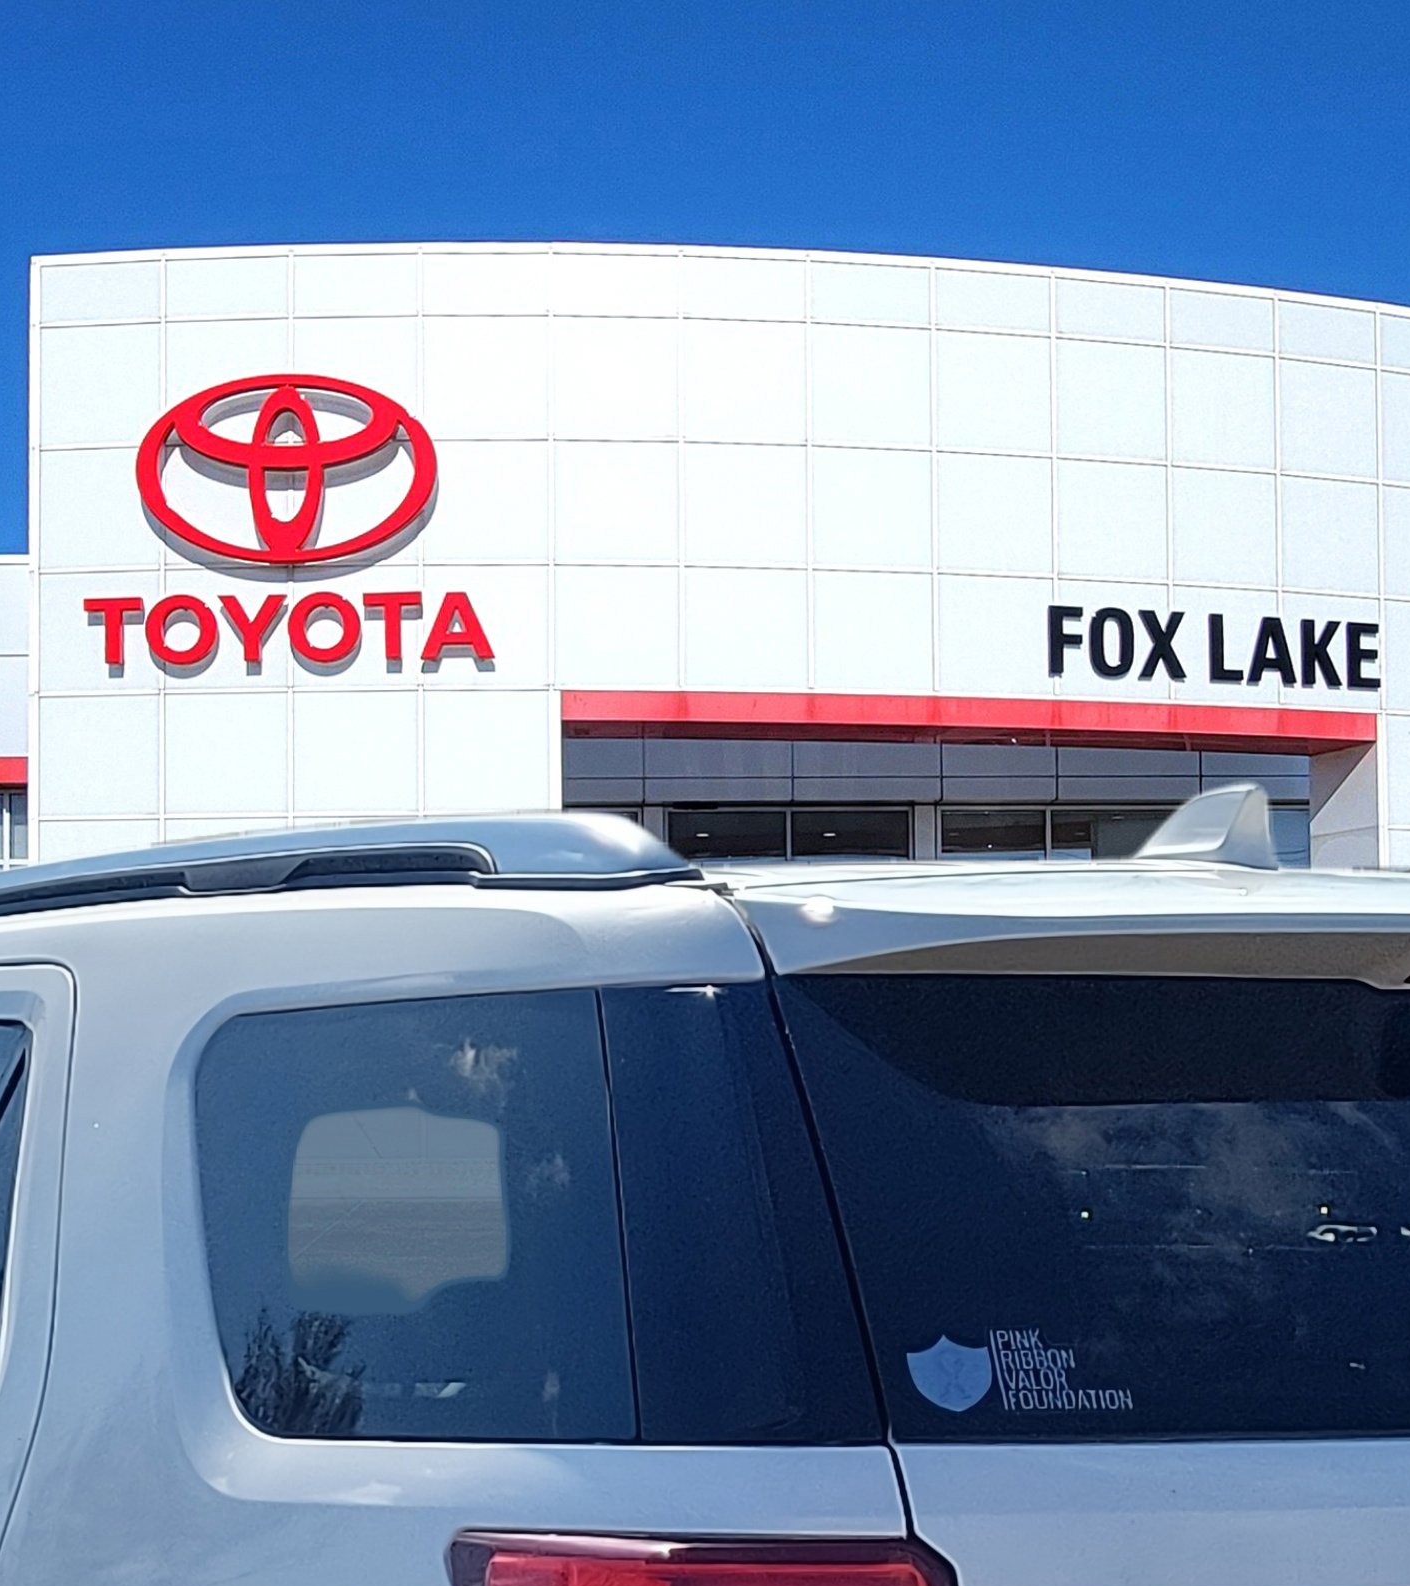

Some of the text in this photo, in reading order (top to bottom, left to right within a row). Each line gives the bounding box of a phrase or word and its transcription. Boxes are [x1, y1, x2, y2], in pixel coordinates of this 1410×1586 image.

[83, 591, 496, 672] TOYOTA
[1047, 604, 1382, 689] FOX LAKE
[996, 1329, 1043, 1349] PINK
[1000, 1349, 1076, 1369] RIBBON
[1004, 1369, 1069, 1389] VALOR
[1009, 1389, 1134, 1410] FOUNDATION
